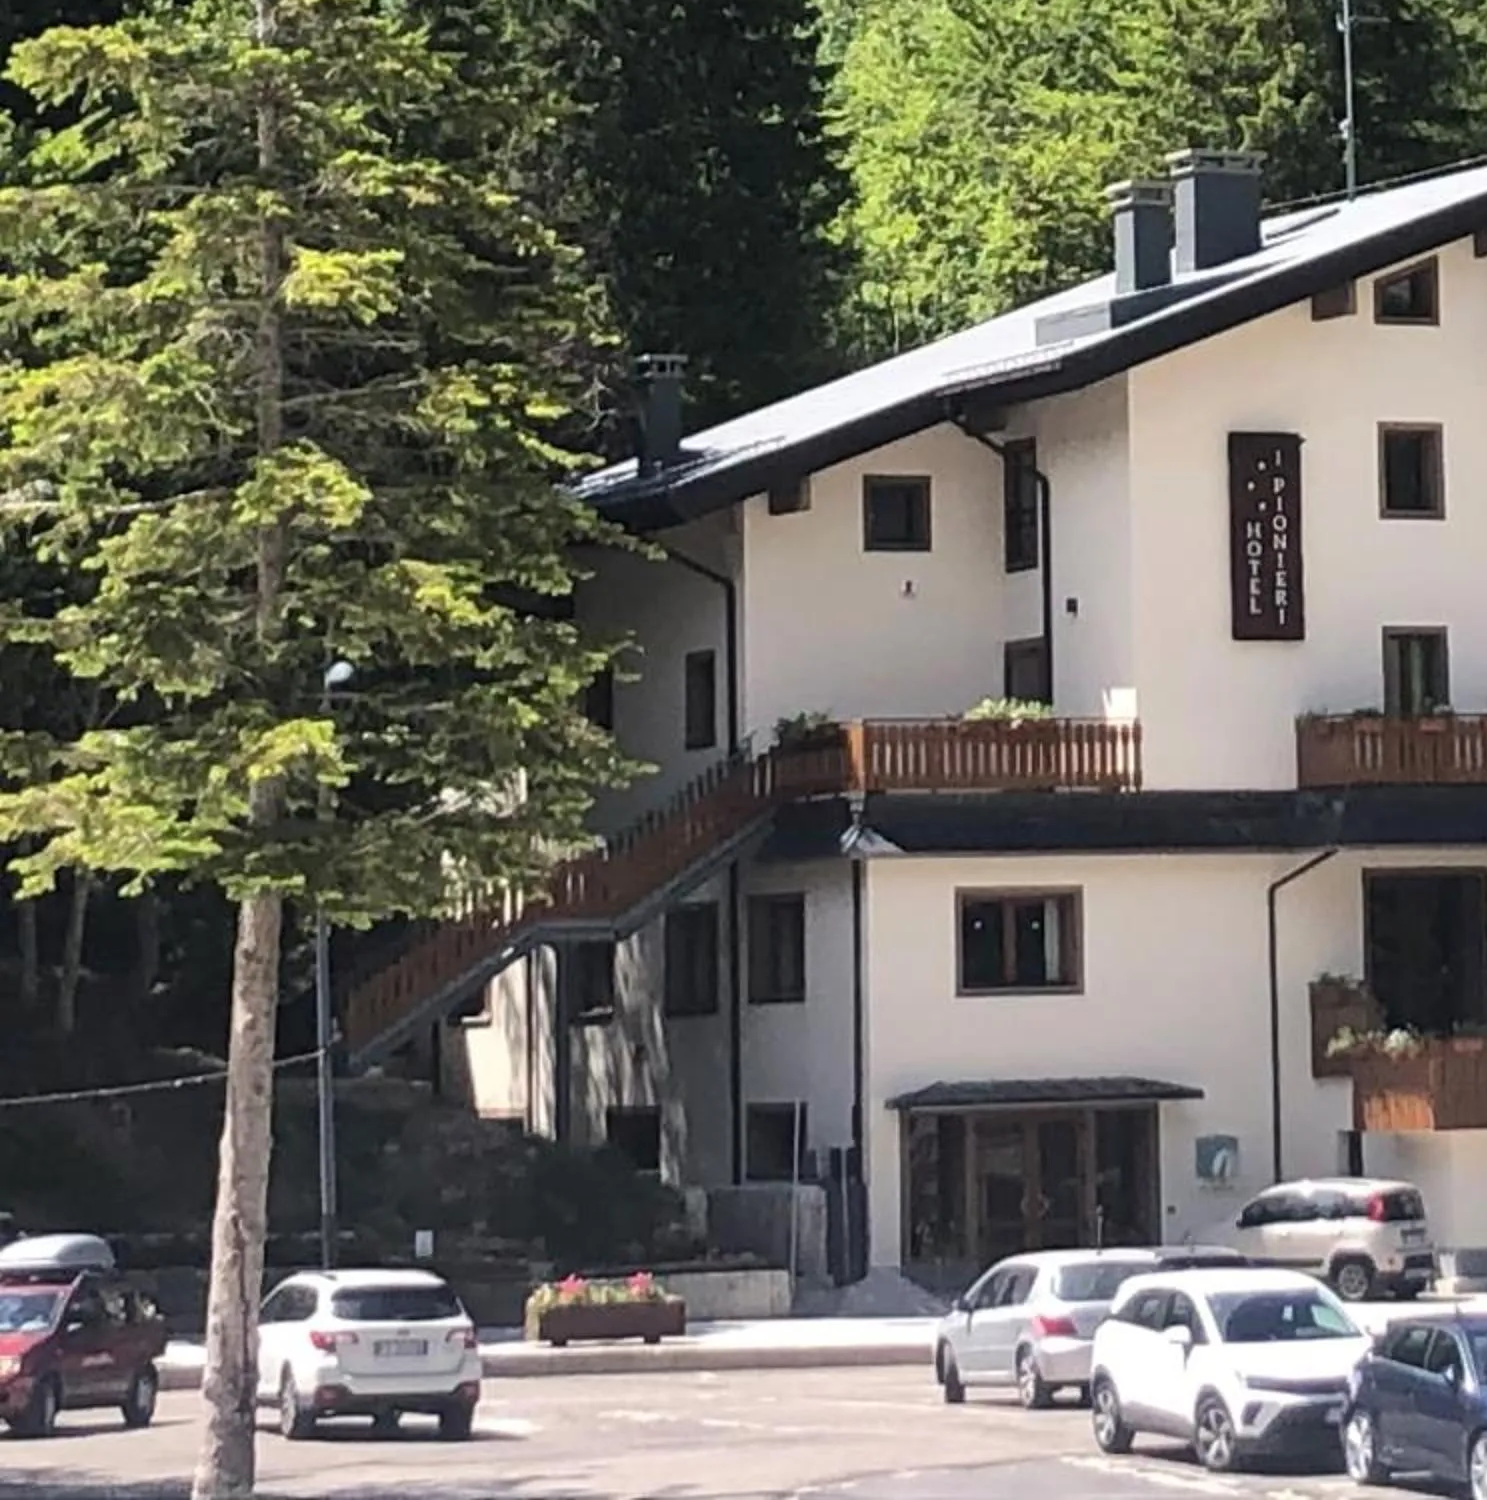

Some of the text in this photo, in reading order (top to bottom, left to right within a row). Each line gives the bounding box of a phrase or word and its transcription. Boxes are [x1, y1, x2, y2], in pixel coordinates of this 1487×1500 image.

[1246, 520, 1263, 616] HOTEL
[1272, 449, 1288, 626] I PIONIERI
